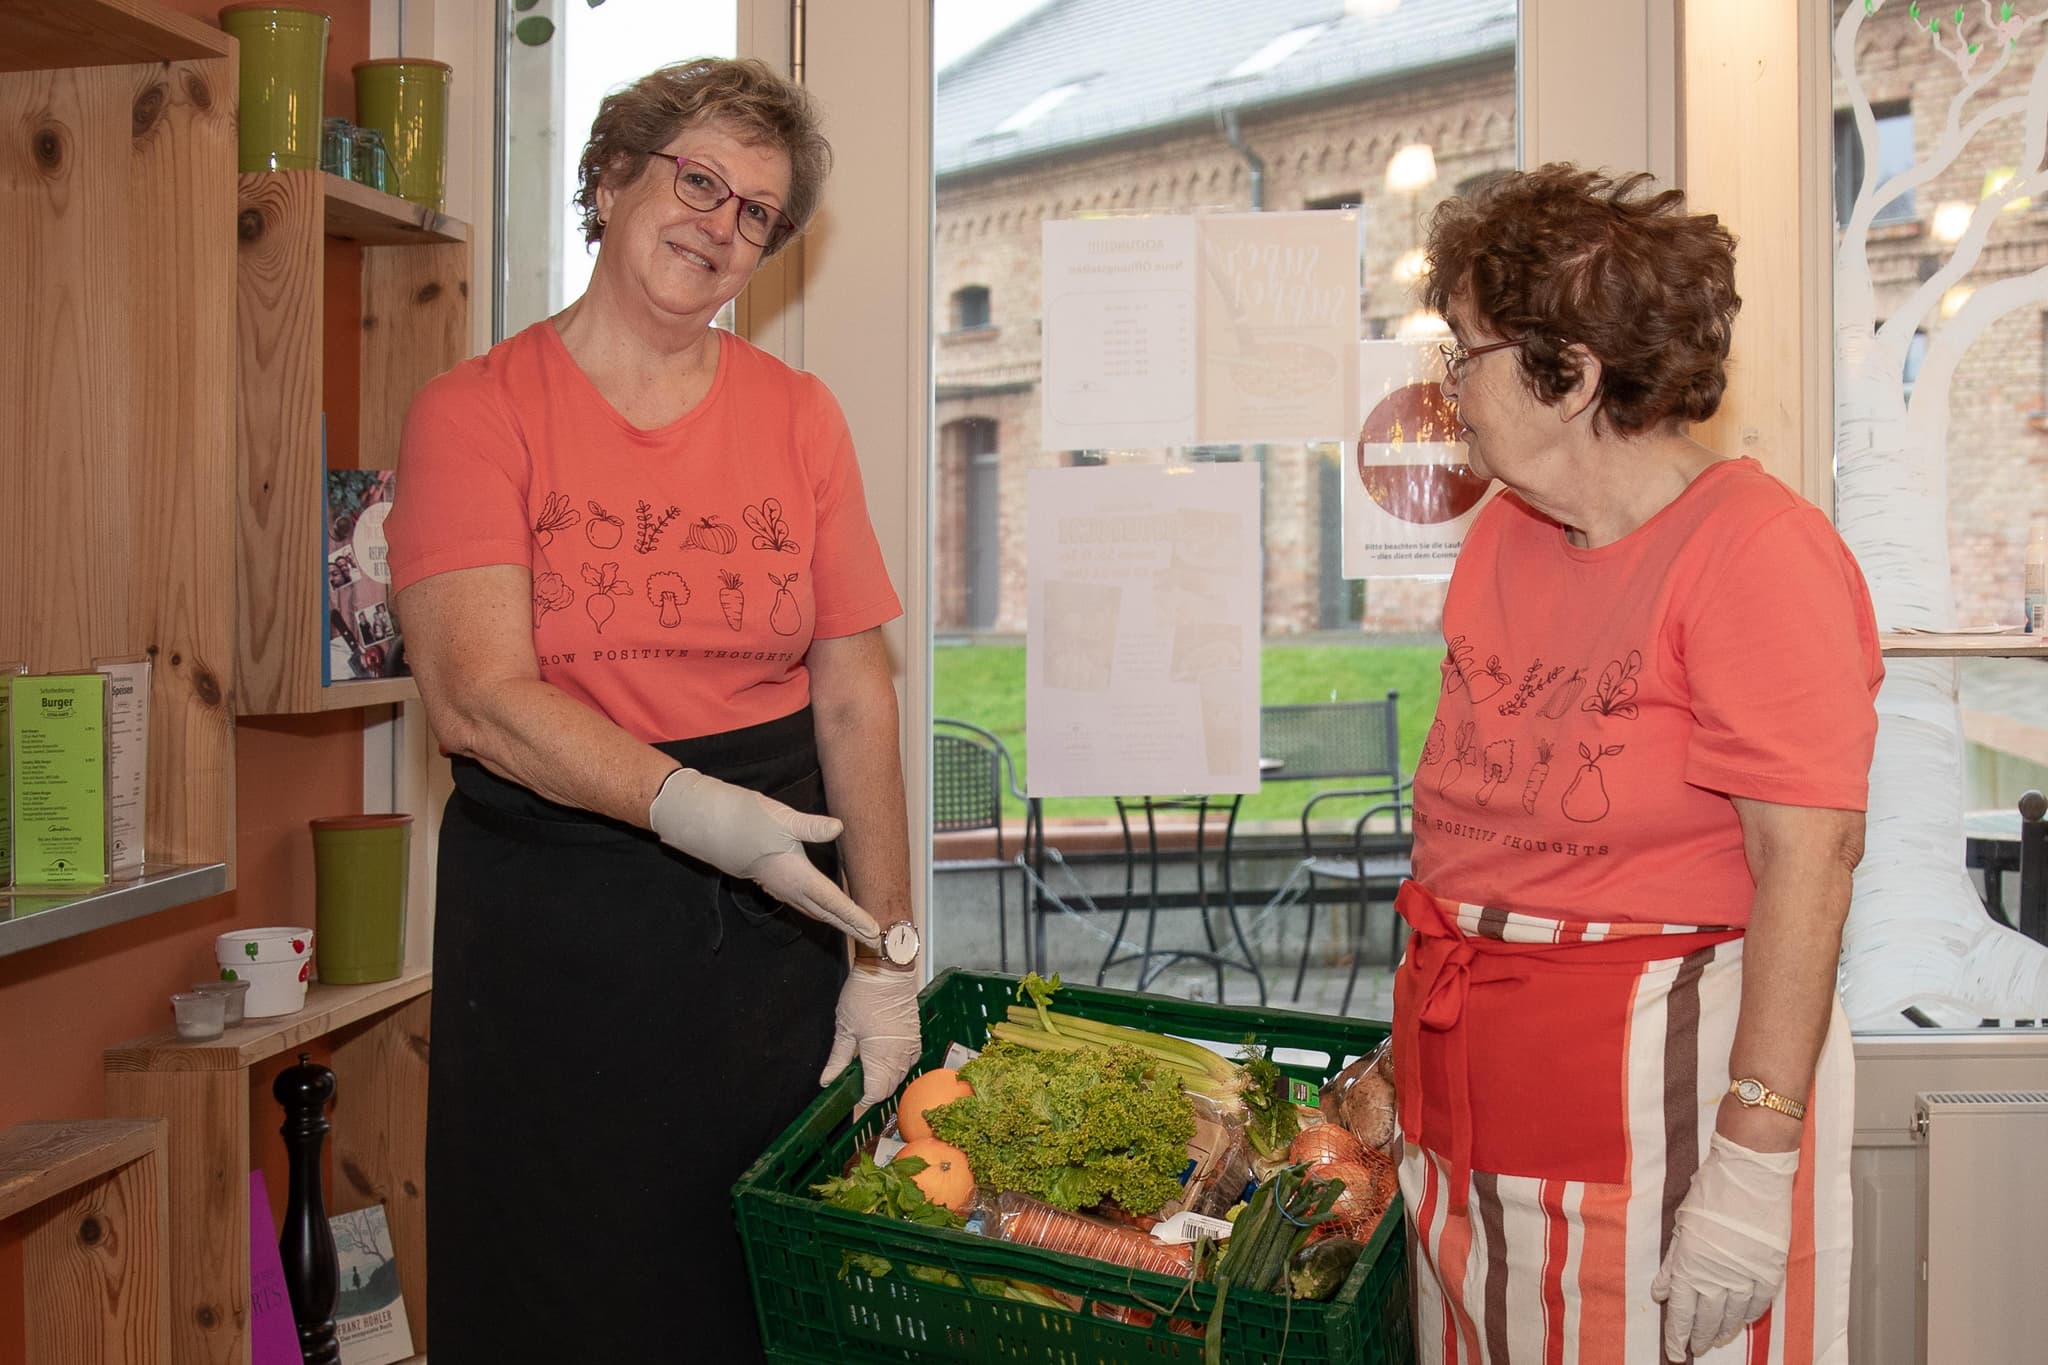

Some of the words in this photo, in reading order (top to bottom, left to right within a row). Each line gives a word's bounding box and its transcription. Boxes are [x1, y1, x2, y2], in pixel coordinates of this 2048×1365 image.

[1384, 542, 1418, 550] beachten
[593, 649, 688, 661] POSITIVE
[703, 649, 794, 662] THOUGHTS
[41, 697, 74, 710] Burger
[1502, 836, 1610, 856] THOUGHTS
[337, 1320, 361, 1336] FRANZ
[363, 1310, 392, 1328] HOHLER
